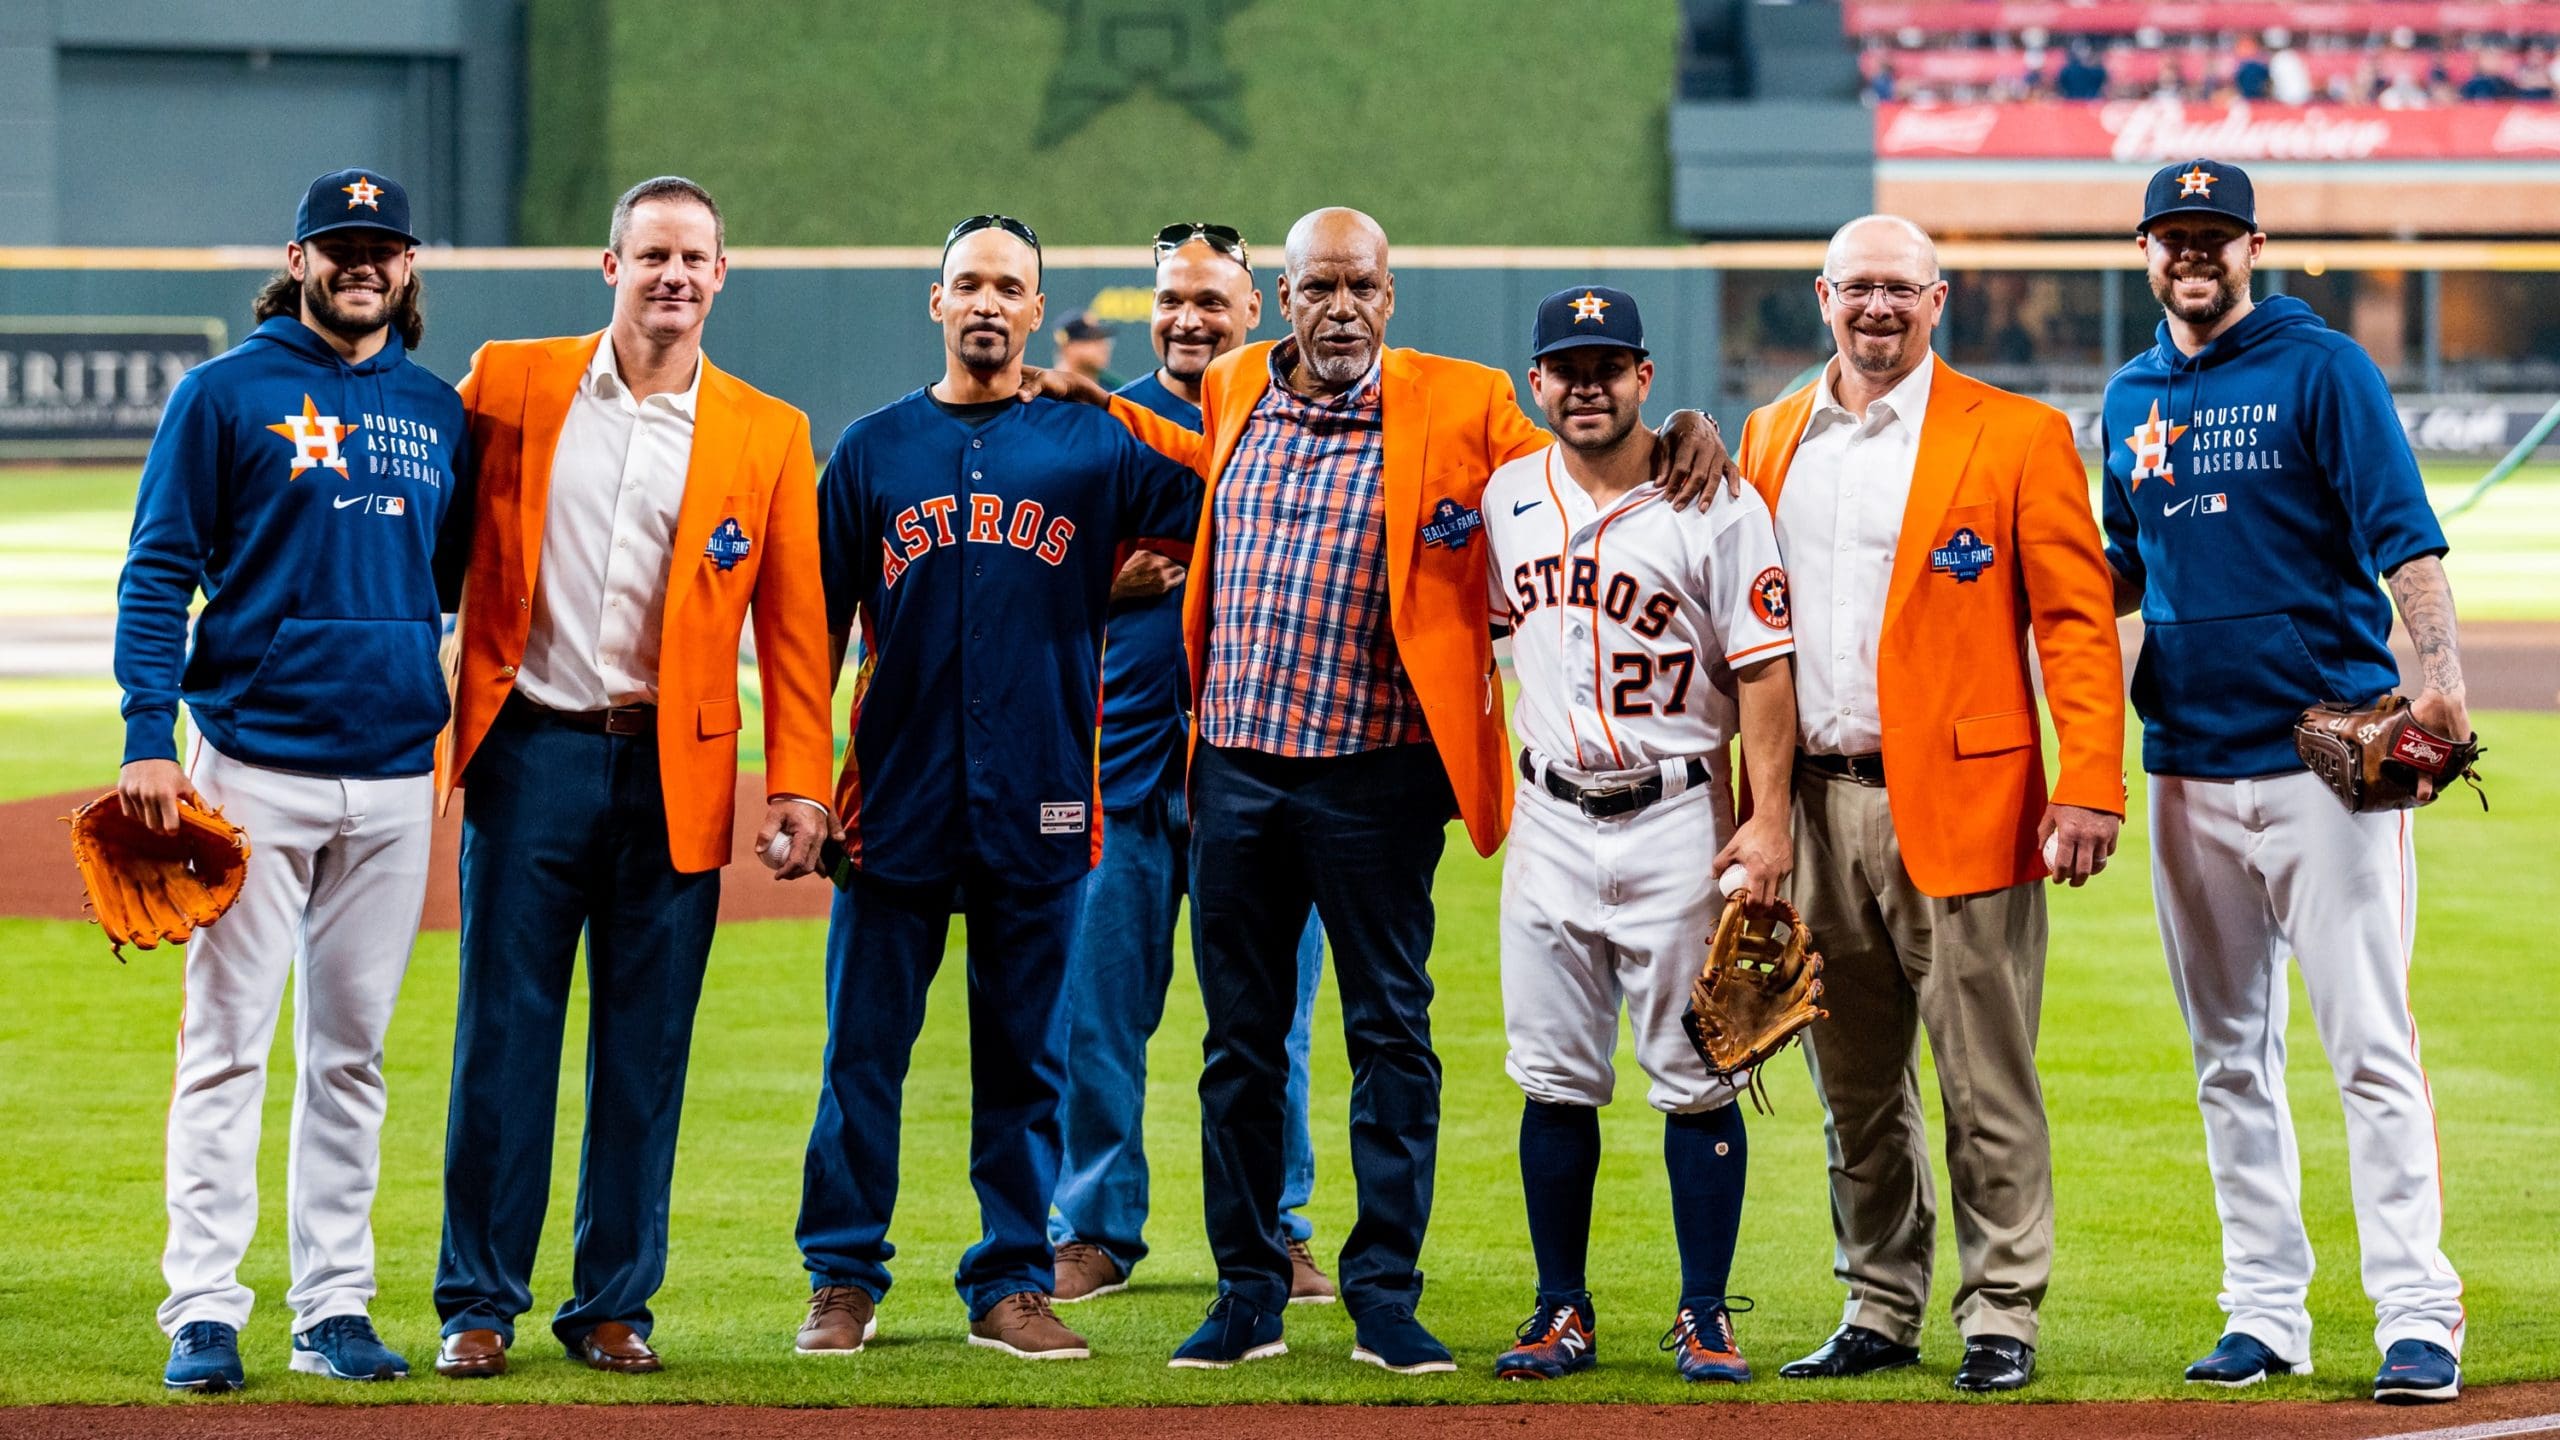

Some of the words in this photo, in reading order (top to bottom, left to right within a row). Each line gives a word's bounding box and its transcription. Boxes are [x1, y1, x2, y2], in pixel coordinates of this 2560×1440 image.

[362, 413, 438, 445] HOUSTON
[2193, 403, 2278, 428] HOUSTON
[284, 415, 347, 468] H
[367, 434, 429, 461] ASTROS
[2131, 418, 2174, 481] H
[2192, 428, 2258, 452] ASTROS
[369, 455, 441, 489] BASEBALL
[2193, 450, 2283, 475] BASEBALL
[882, 493, 1076, 590] ASTROS
[1422, 524, 1450, 542] HALL
[1456, 510, 1481, 530] FAME
[707, 537, 724, 552] ALL
[1933, 551, 1961, 566] HALL
[1971, 547, 1993, 563] FAME
[1508, 554, 1680, 641] ASTROS
[1612, 648, 1696, 718] 27
